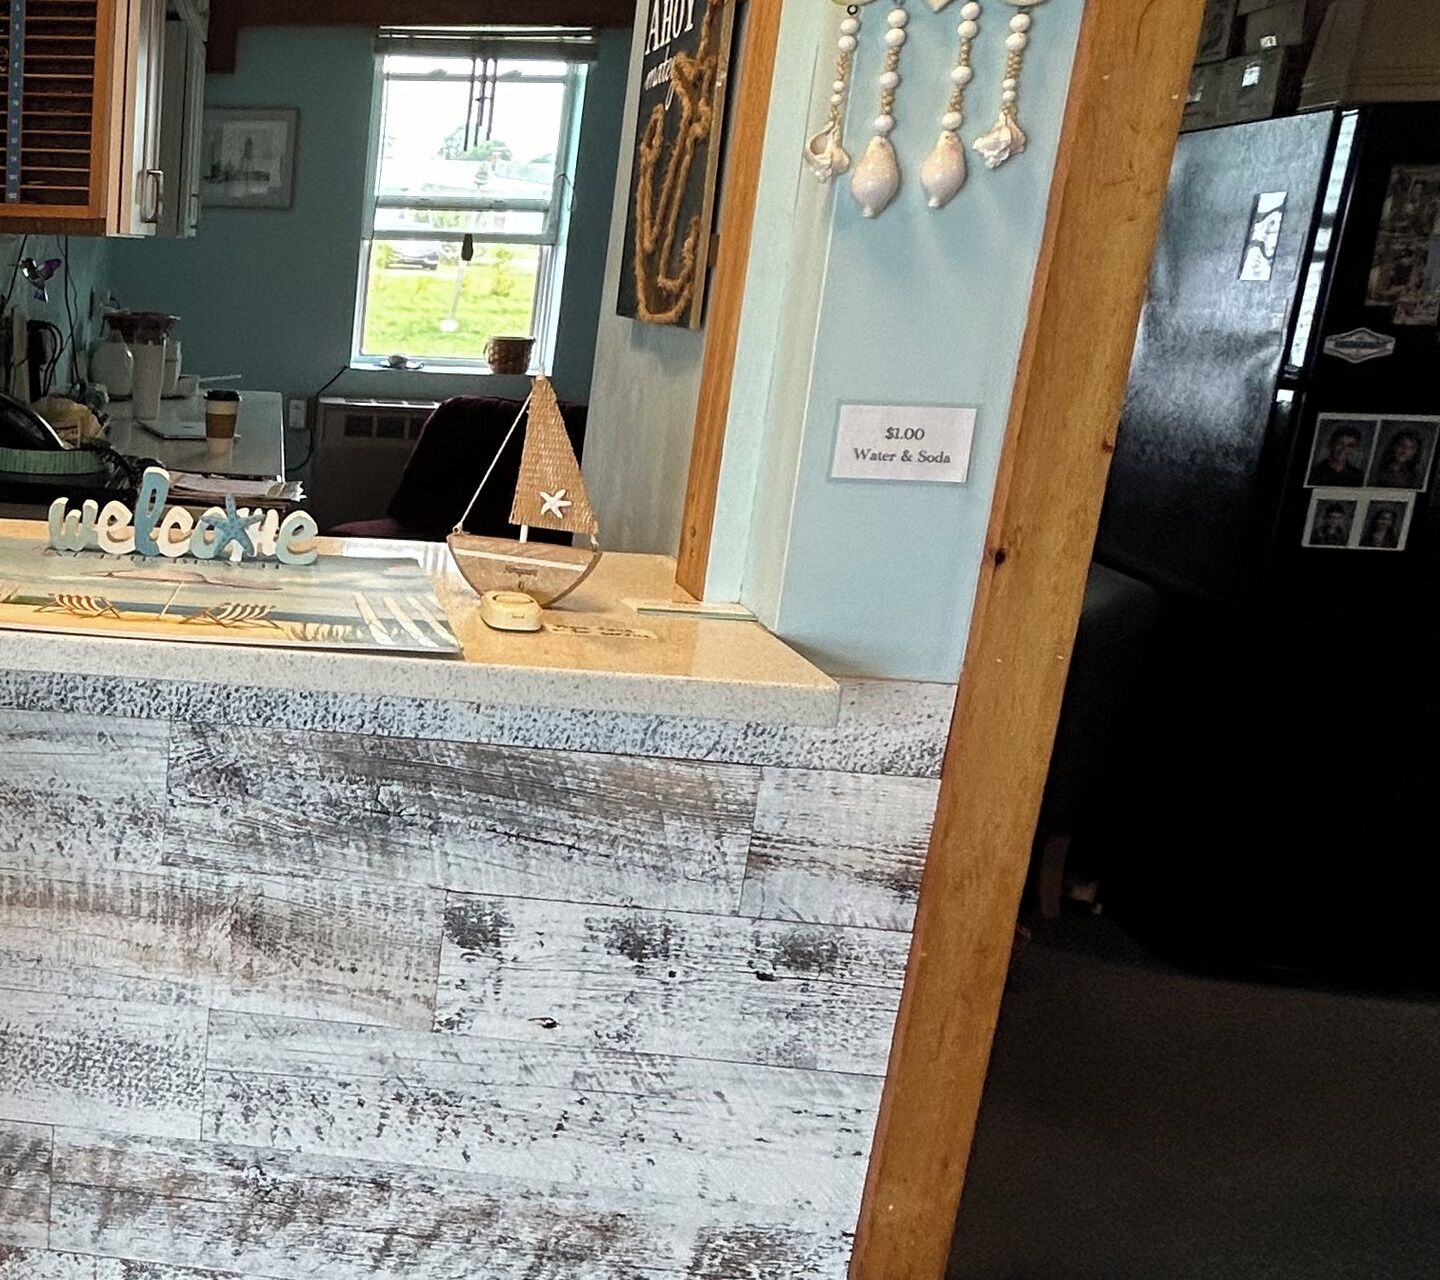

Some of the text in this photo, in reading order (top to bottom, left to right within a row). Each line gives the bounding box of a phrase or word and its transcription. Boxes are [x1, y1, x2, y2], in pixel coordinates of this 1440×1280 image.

[885, 426, 926, 441] $1.00
[853, 448, 951, 464] Water & Soda
